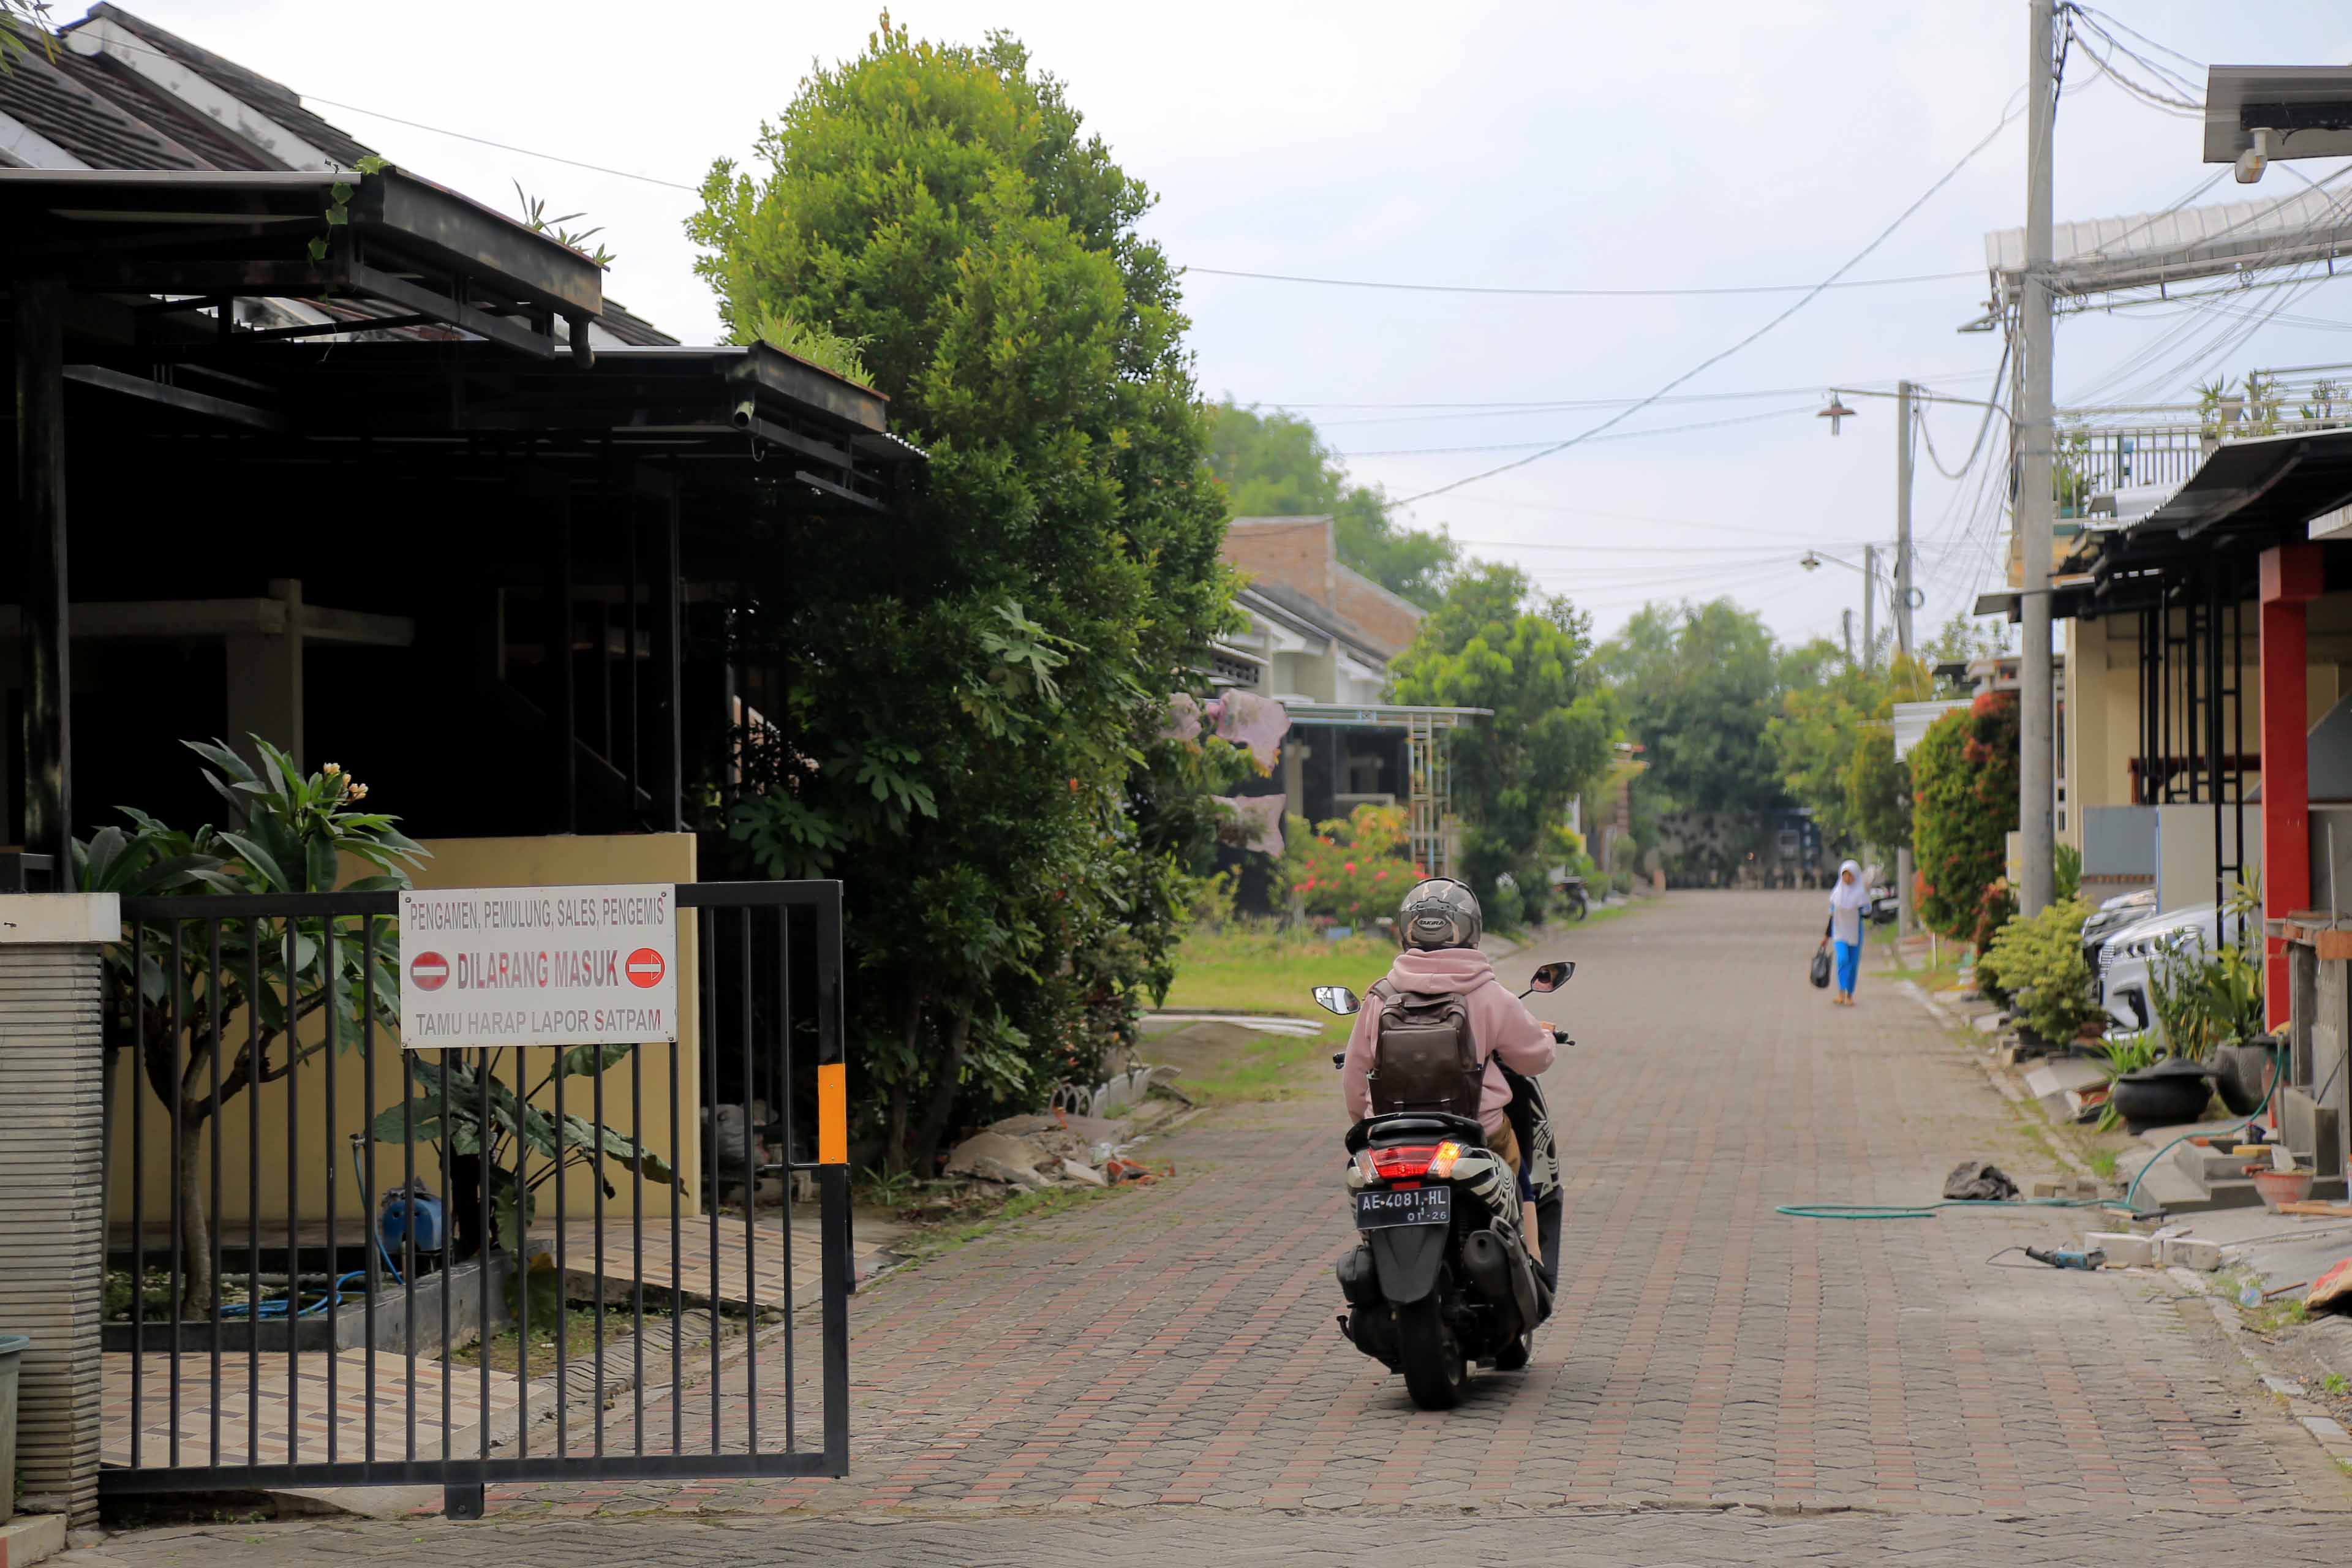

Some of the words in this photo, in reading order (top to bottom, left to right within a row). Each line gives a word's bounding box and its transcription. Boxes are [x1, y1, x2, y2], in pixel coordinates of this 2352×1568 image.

[410, 902, 481, 935] PENGAMEN,
[484, 900, 554, 932] PEMULUNG,
[557, 899, 599, 931] SALES,
[603, 897, 664, 925] PENGEMIS
[458, 951, 549, 989] DILARANG
[554, 949, 619, 987] MASUK
[416, 1012, 462, 1035] TAMU
[468, 1011, 526, 1034] HARAP
[532, 1010, 589, 1033] LAPOR
[594, 1009, 661, 1031] SATPAM
[1362, 1195, 1381, 1211] AE
[1428, 1190, 1446, 1205] HL
